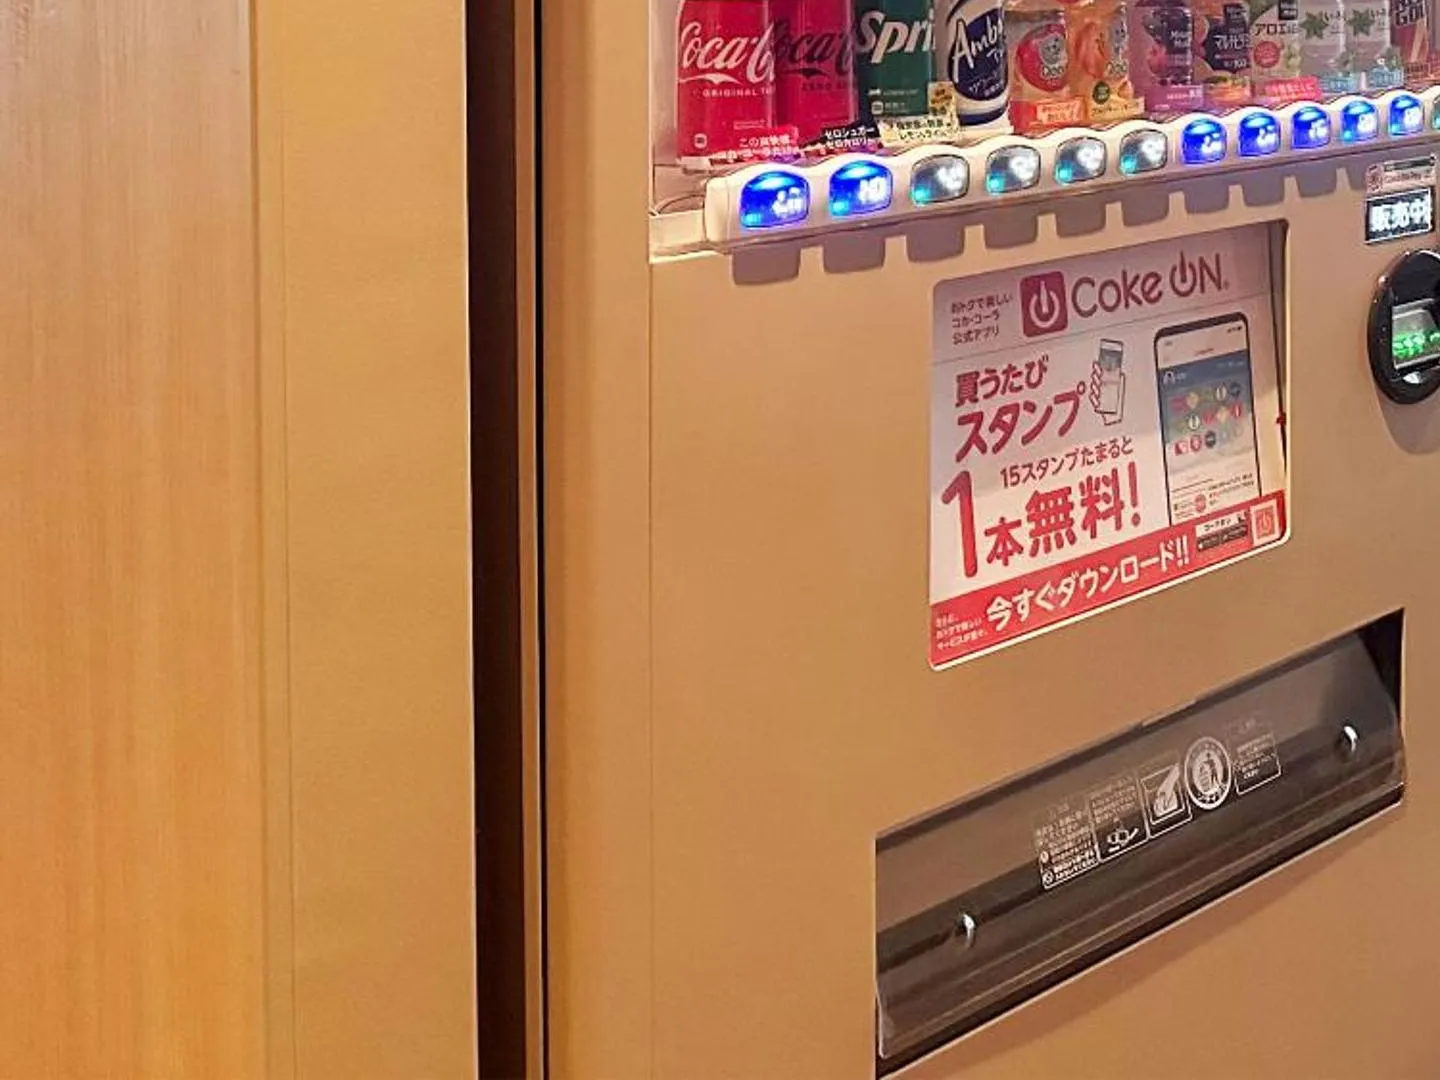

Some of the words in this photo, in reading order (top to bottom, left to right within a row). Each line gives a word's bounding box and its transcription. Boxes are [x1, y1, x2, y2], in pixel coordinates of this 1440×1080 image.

[1071, 269, 1163, 318] Coke
[1169, 250, 1223, 298] ON
[955, 354, 1050, 408] 買うたび
[955, 380, 1087, 464] スタンプ
[1000, 435, 1136, 489] 15スタンプたまると
[941, 461, 1142, 579] 1本無料!
